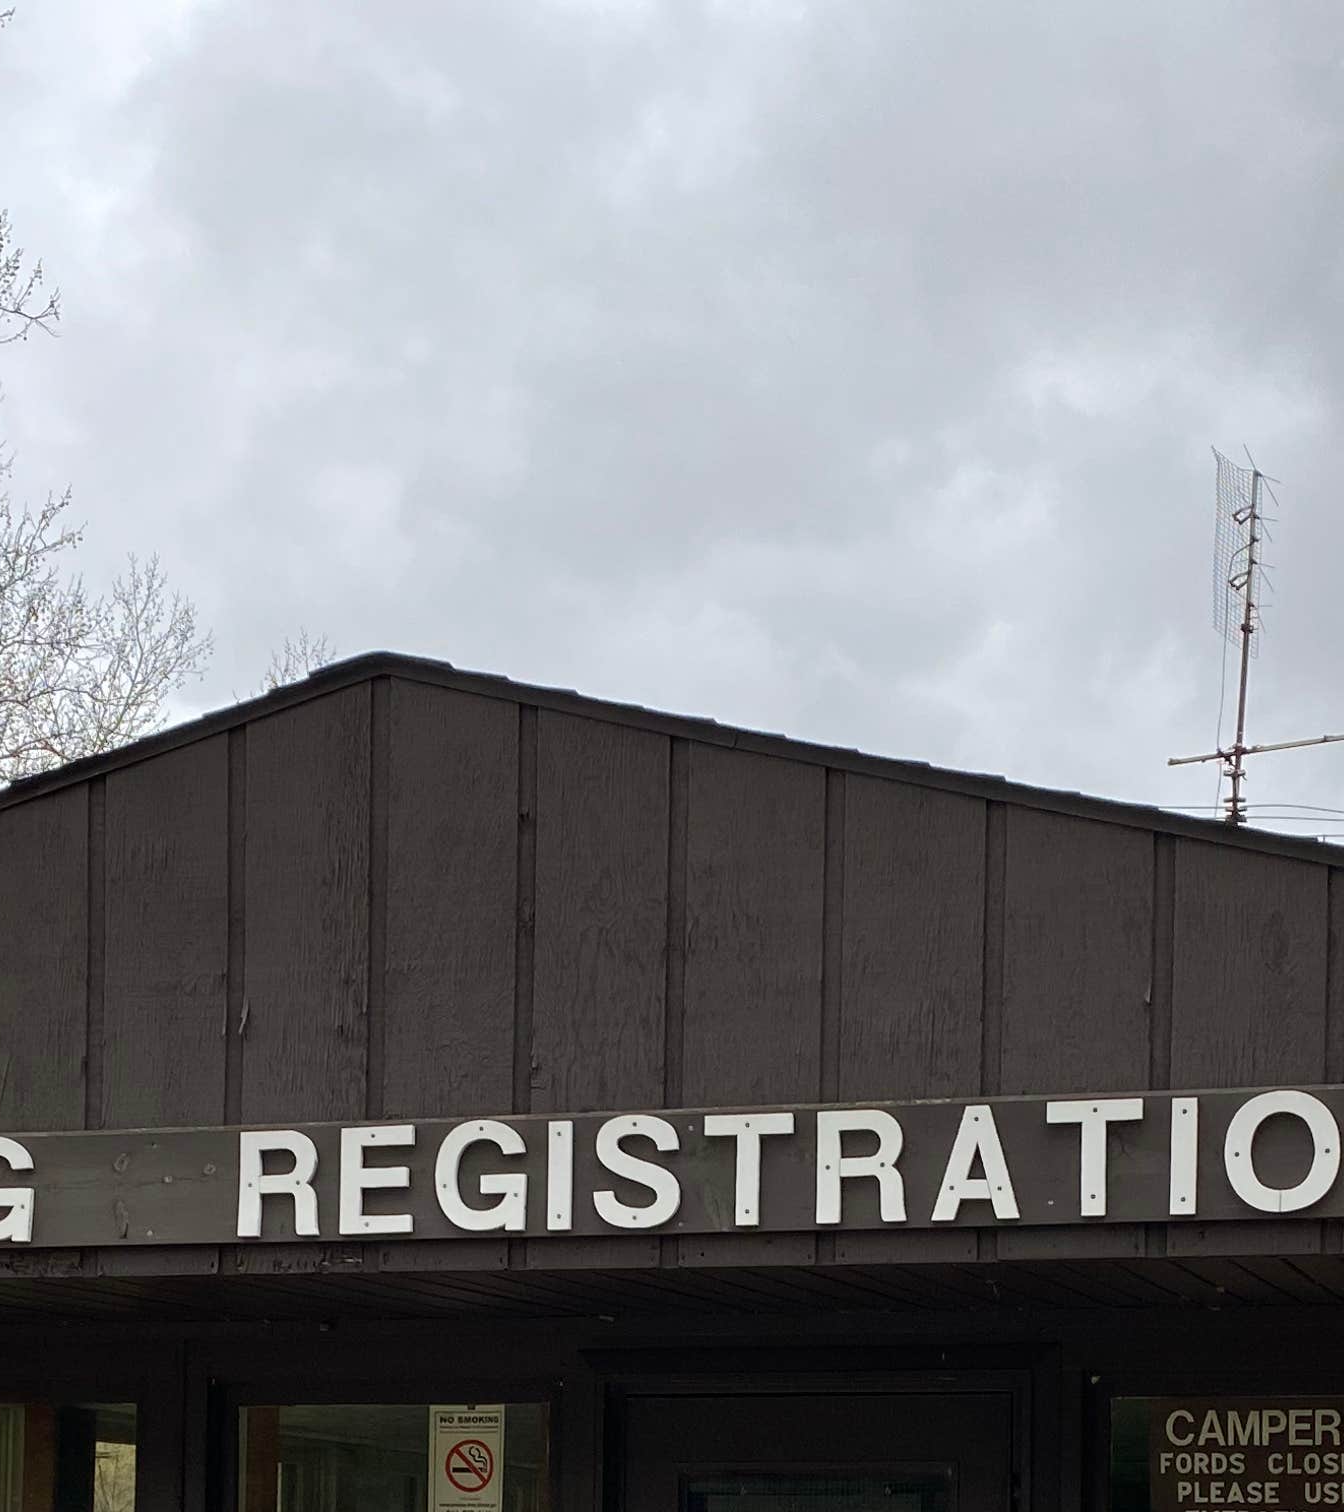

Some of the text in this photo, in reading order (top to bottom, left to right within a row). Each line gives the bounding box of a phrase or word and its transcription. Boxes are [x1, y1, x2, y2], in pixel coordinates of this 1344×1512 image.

[440, 1416, 499, 1424] NO SMOKING
[1161, 1453, 1244, 1474] FORDS
[1178, 1482, 1279, 1503] PLEASE
